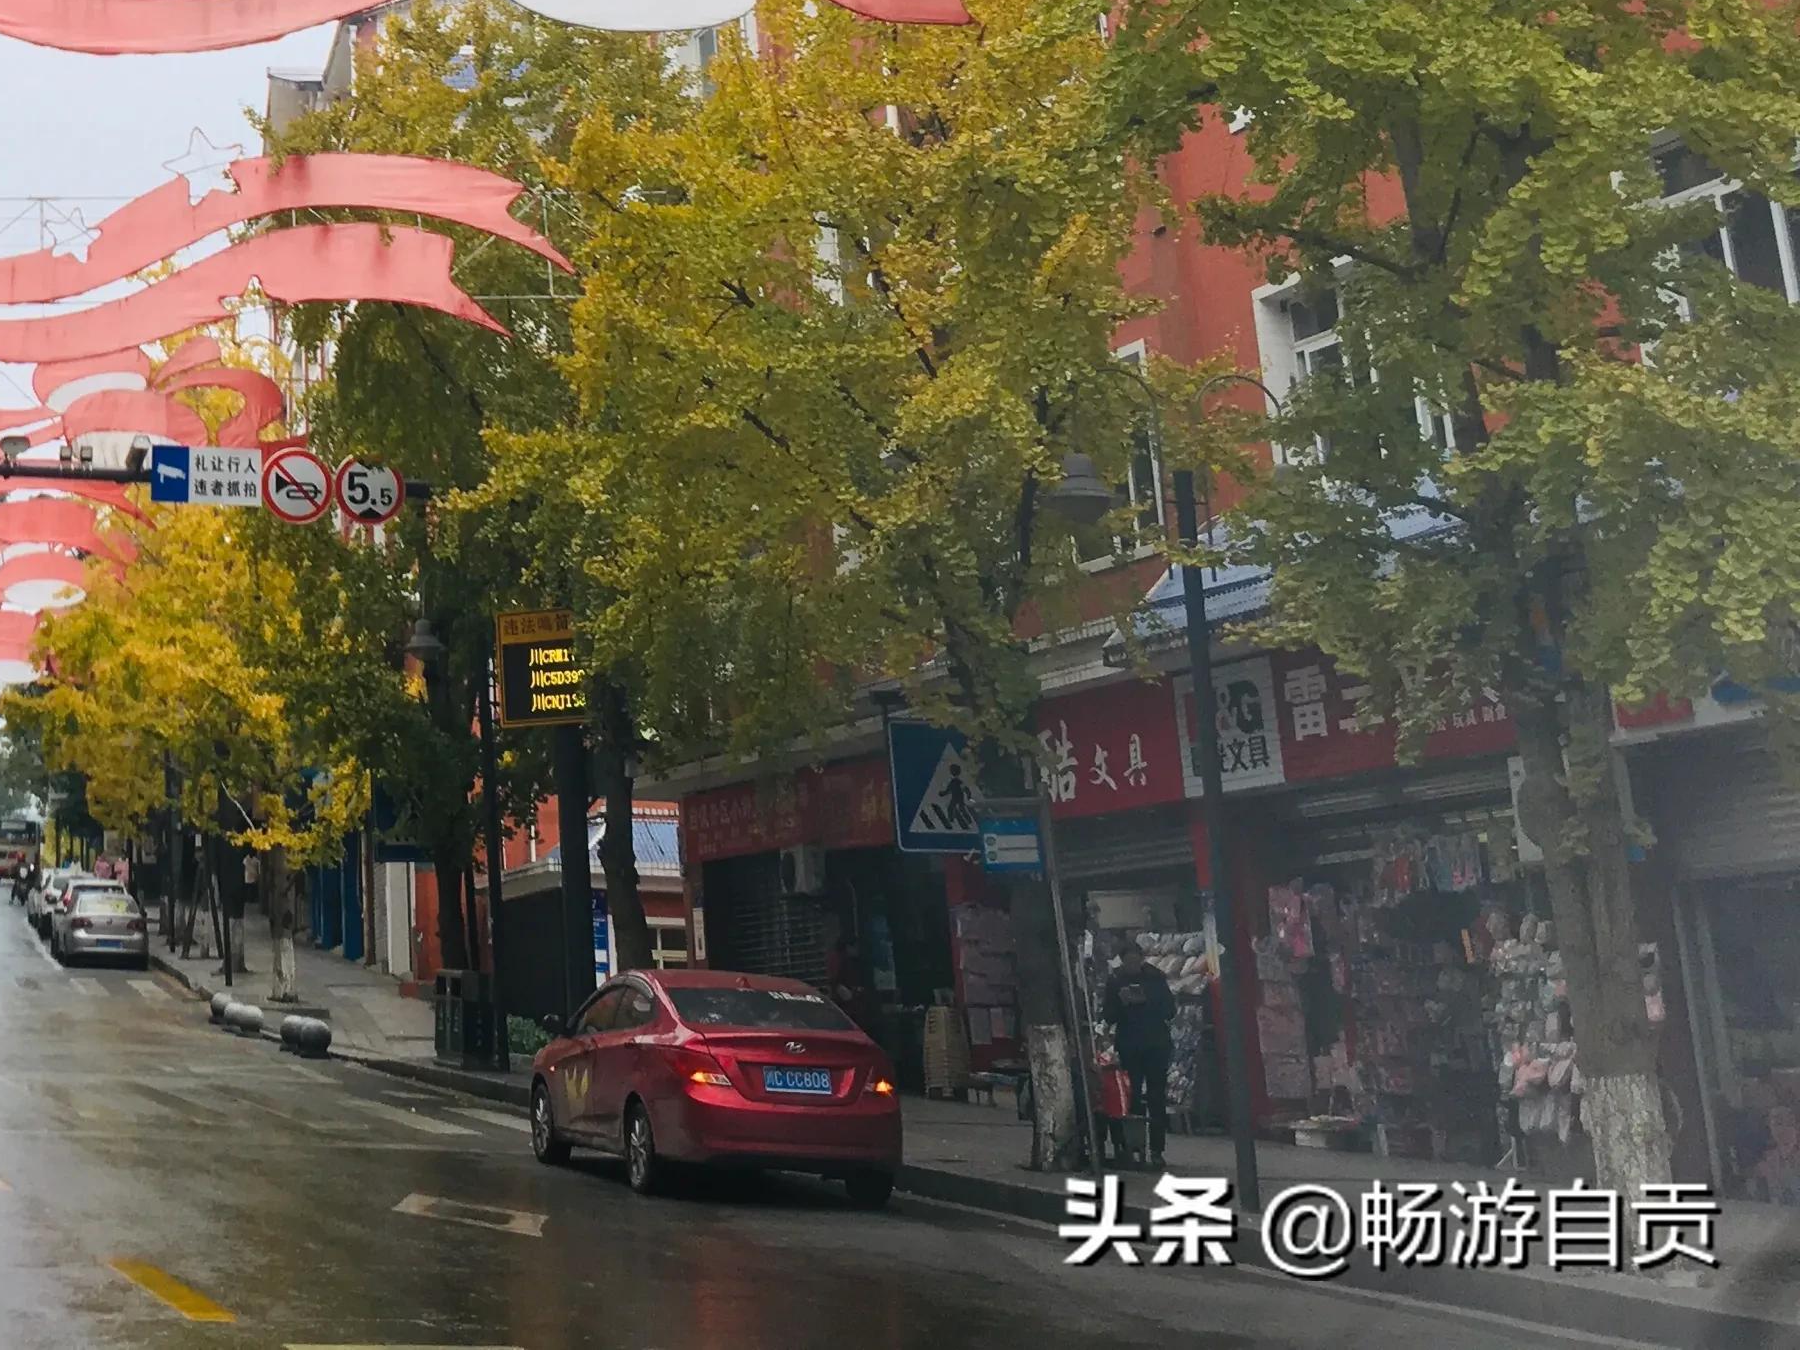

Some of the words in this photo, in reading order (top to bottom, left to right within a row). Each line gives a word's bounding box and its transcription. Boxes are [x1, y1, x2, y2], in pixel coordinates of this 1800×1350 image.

[194, 453, 257, 474] 礼让行人
[194, 479, 257, 498] 违者抓拍
[348, 472, 393, 506] 5.5
